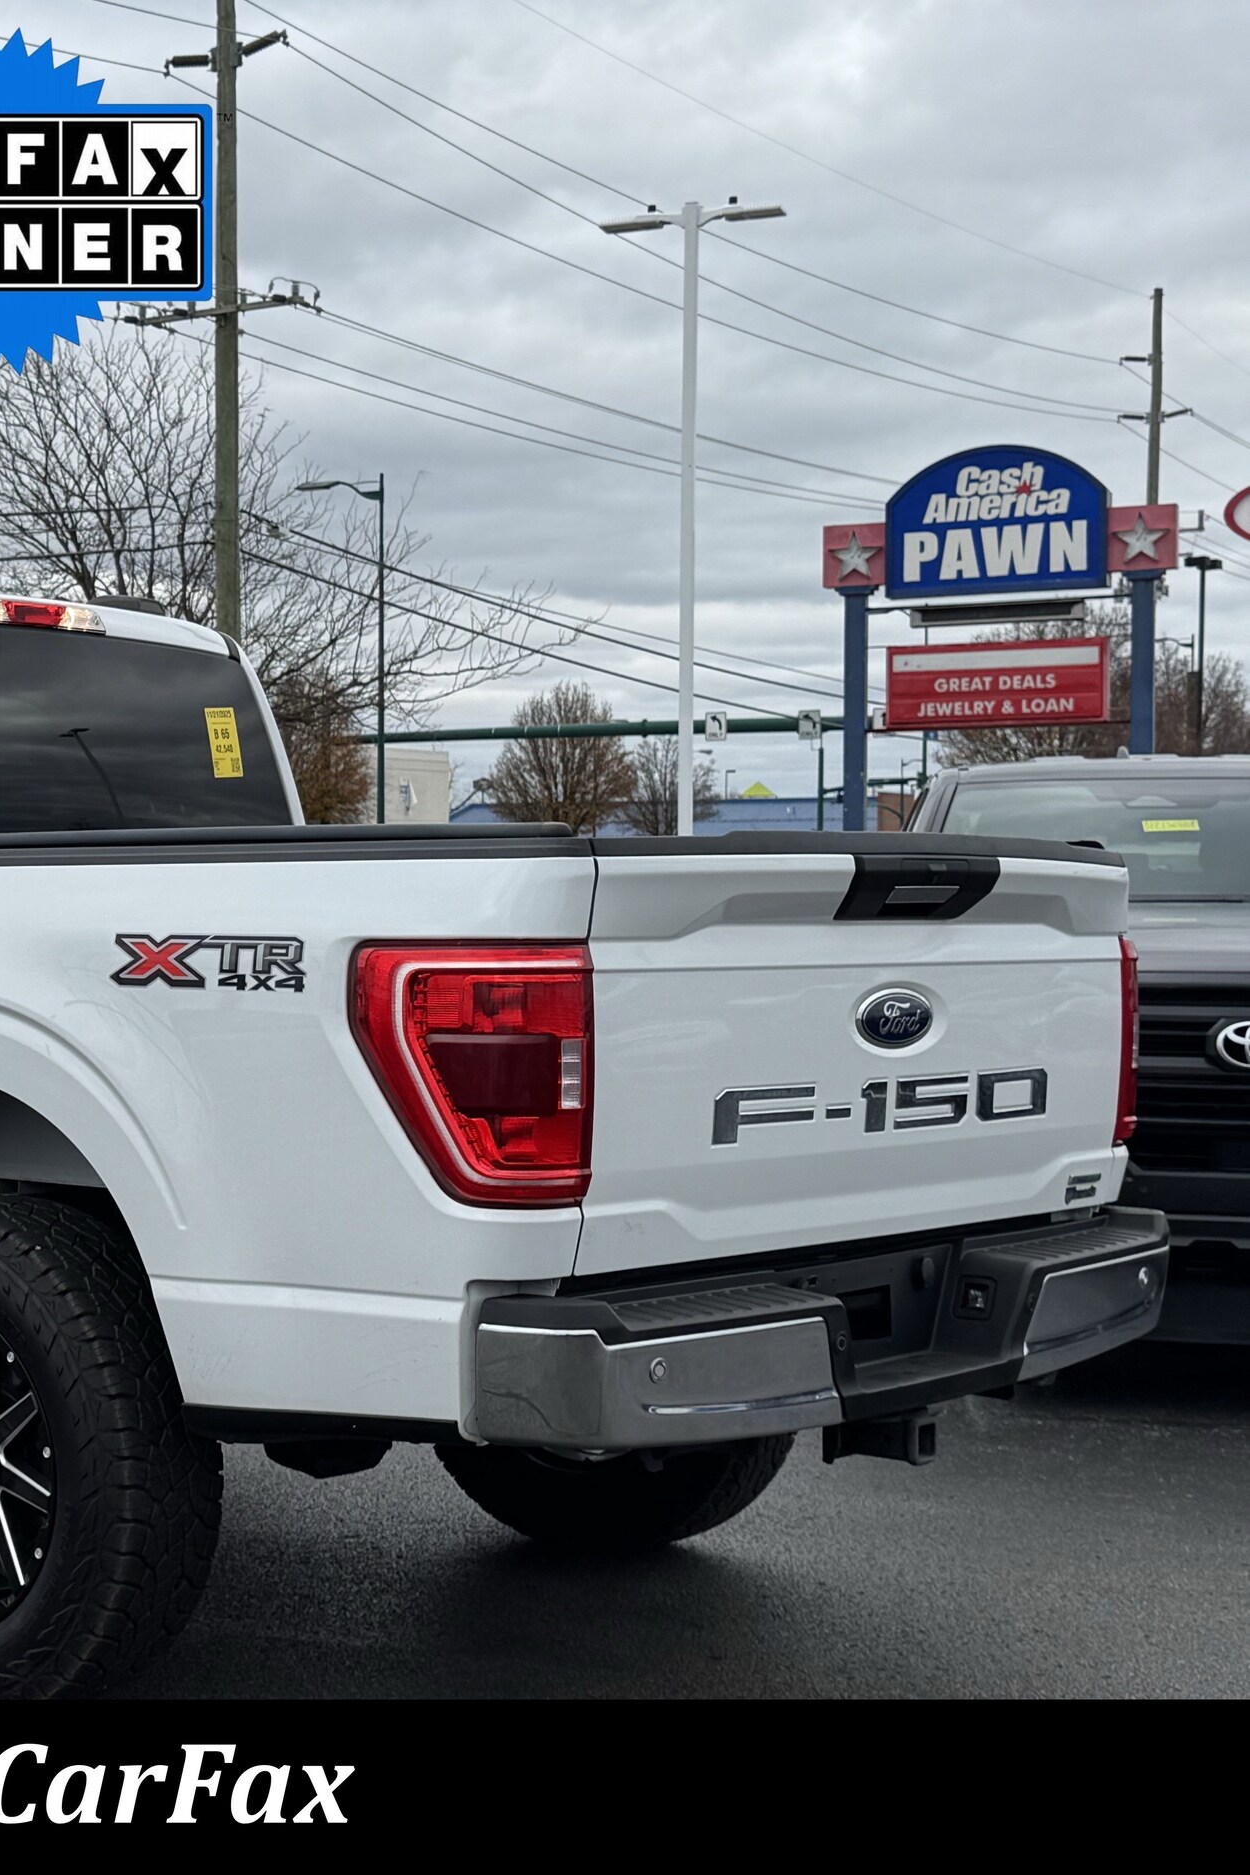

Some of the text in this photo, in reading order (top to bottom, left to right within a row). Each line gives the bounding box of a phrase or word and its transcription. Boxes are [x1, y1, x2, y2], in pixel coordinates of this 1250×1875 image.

[956, 461, 1044, 497] Cash
[922, 488, 1071, 524] America
[903, 519, 1088, 583] PAWN
[934, 673, 1057, 693] GREAT DEALS
[917, 697, 1075, 717] JEWELRY & LOAN
[879, 1000, 921, 1035] Ford
[711, 1066, 1048, 1148] F-150
